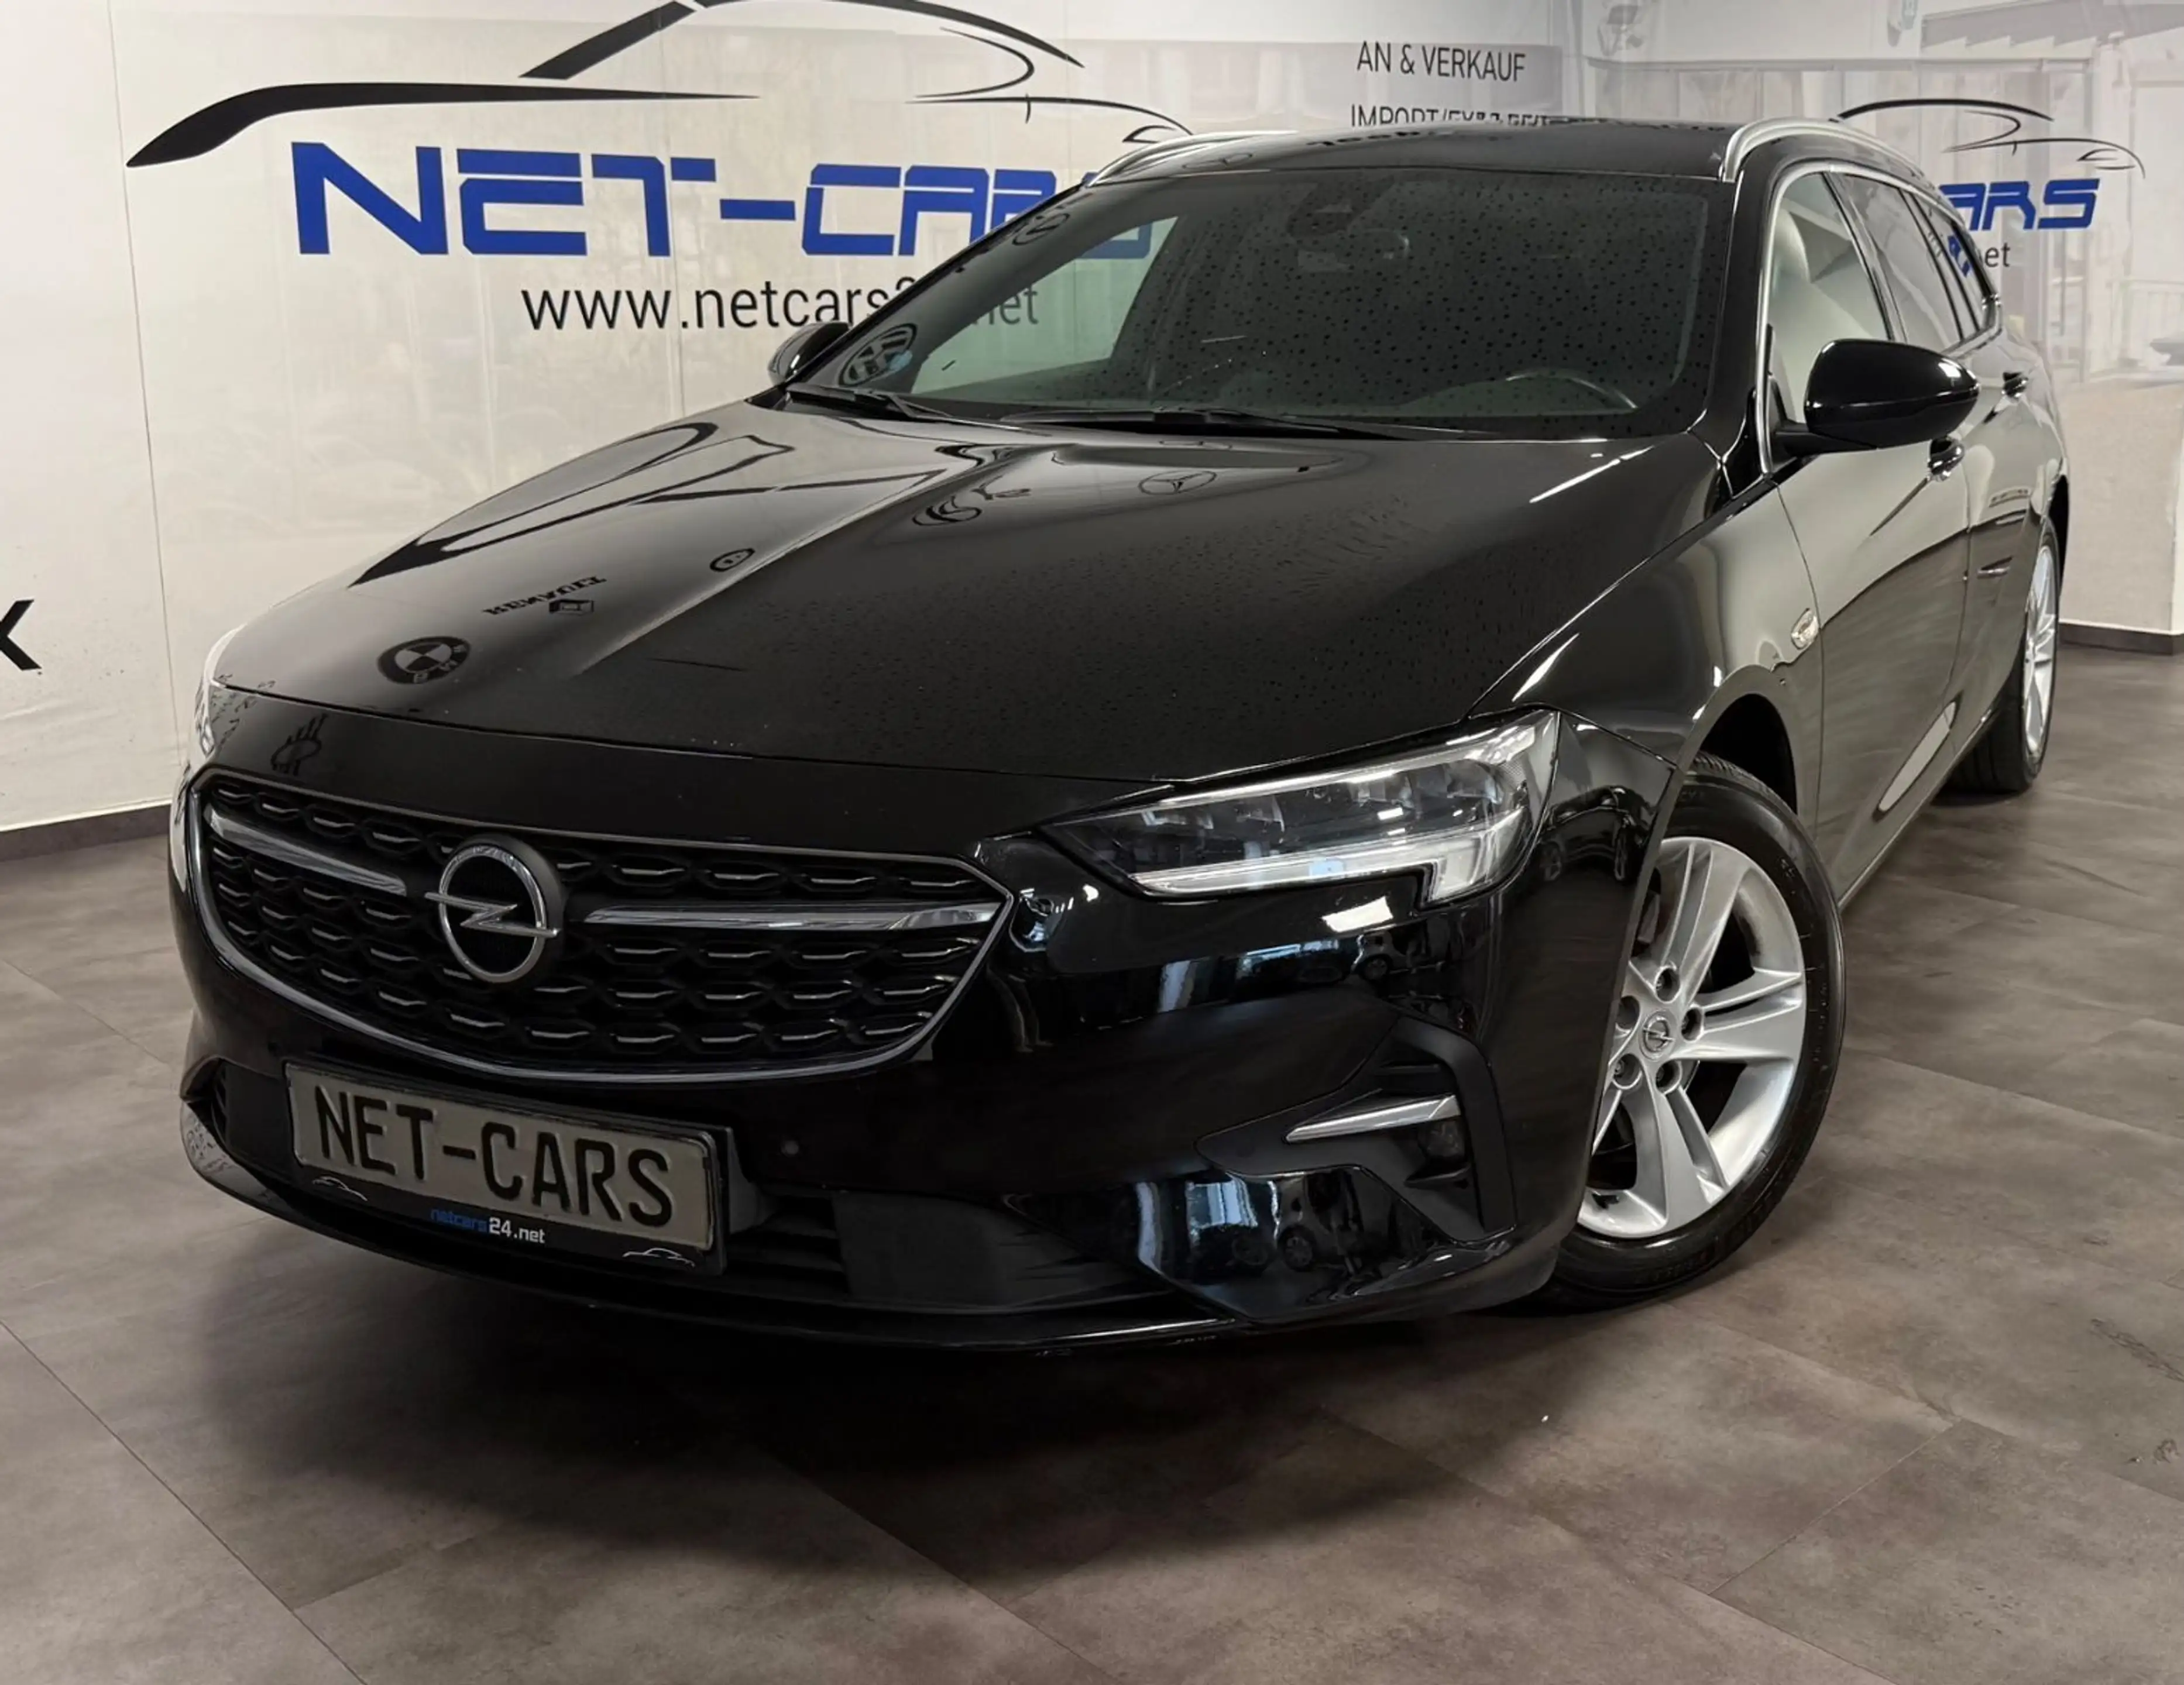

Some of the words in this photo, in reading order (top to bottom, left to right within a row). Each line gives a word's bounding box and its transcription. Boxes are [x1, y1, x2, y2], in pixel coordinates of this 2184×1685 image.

[1357, 40, 1392, 73] AN
[1400, 43, 1416, 75] &
[1421, 44, 1526, 82] VERKAUF
[1939, 178, 2101, 231] ARS
[314, 1085, 674, 1227] NET-CARS
[431, 1208, 546, 1244] netcars24.net
